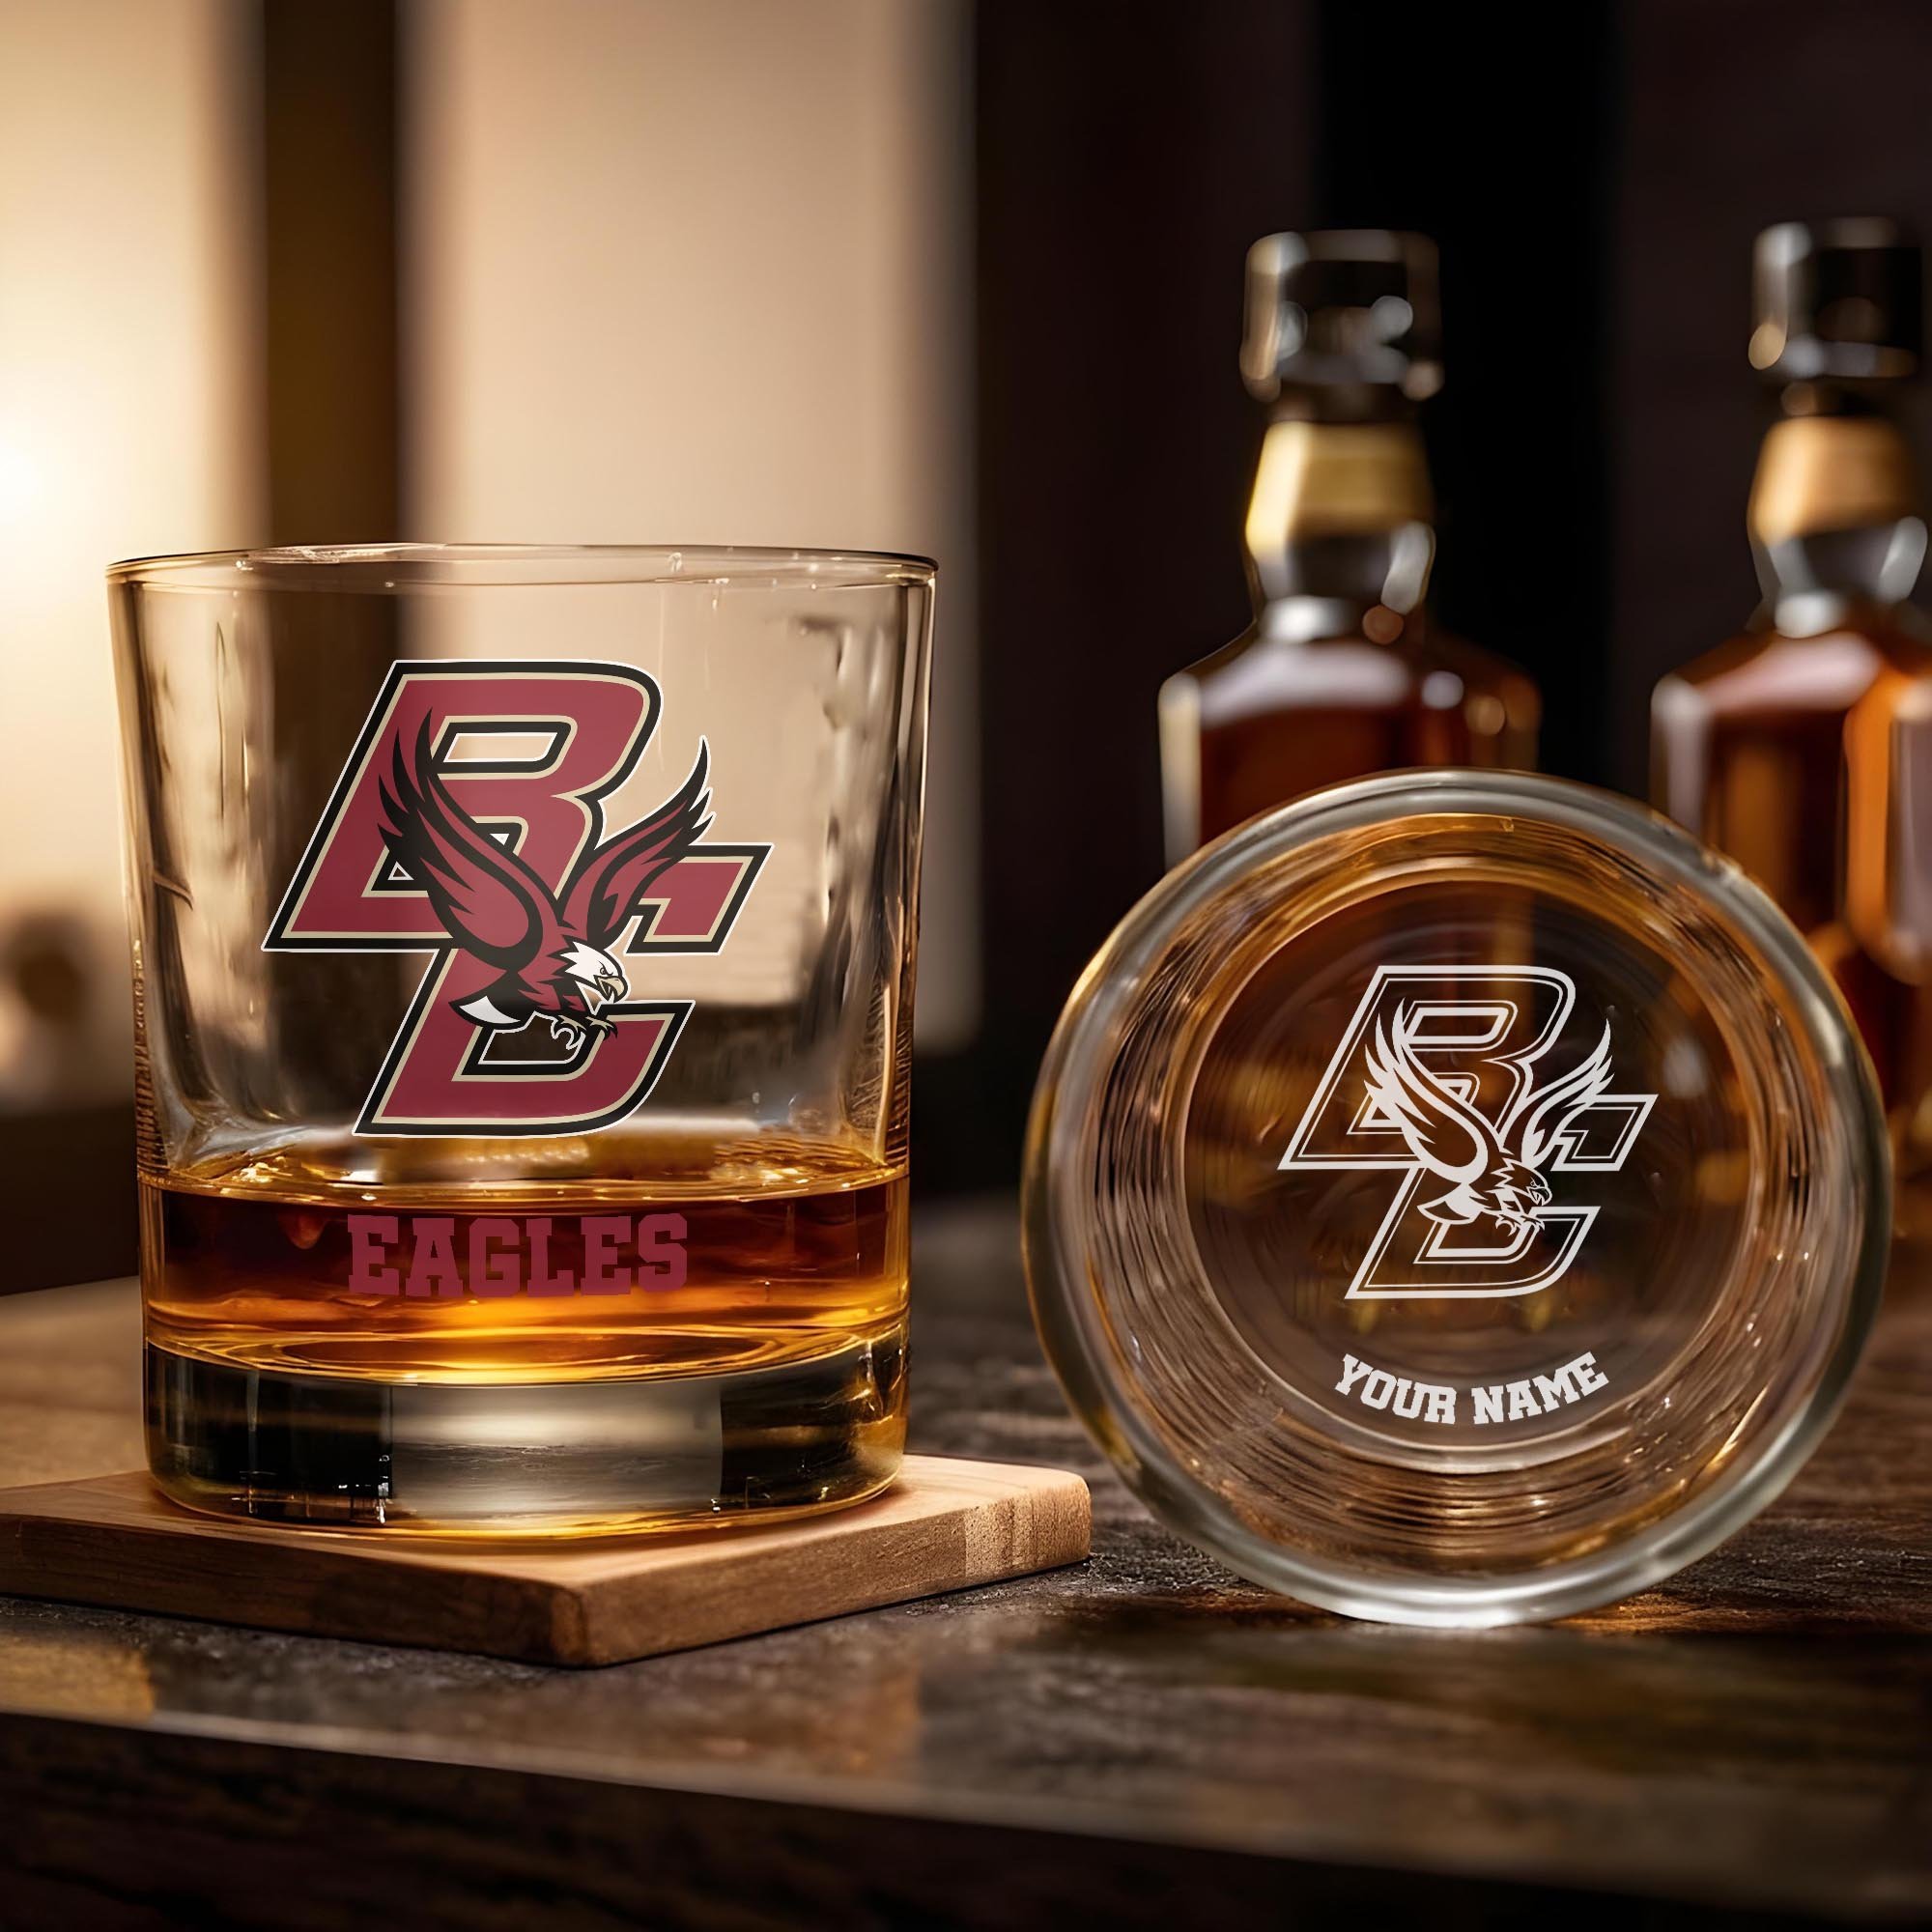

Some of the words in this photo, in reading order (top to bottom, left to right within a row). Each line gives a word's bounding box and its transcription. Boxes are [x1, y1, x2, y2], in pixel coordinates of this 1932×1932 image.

[347, 1213, 689, 1297] EAGLES
[1335, 1354, 1457, 1425] YOUR
[1472, 1351, 1609, 1425] NAME
